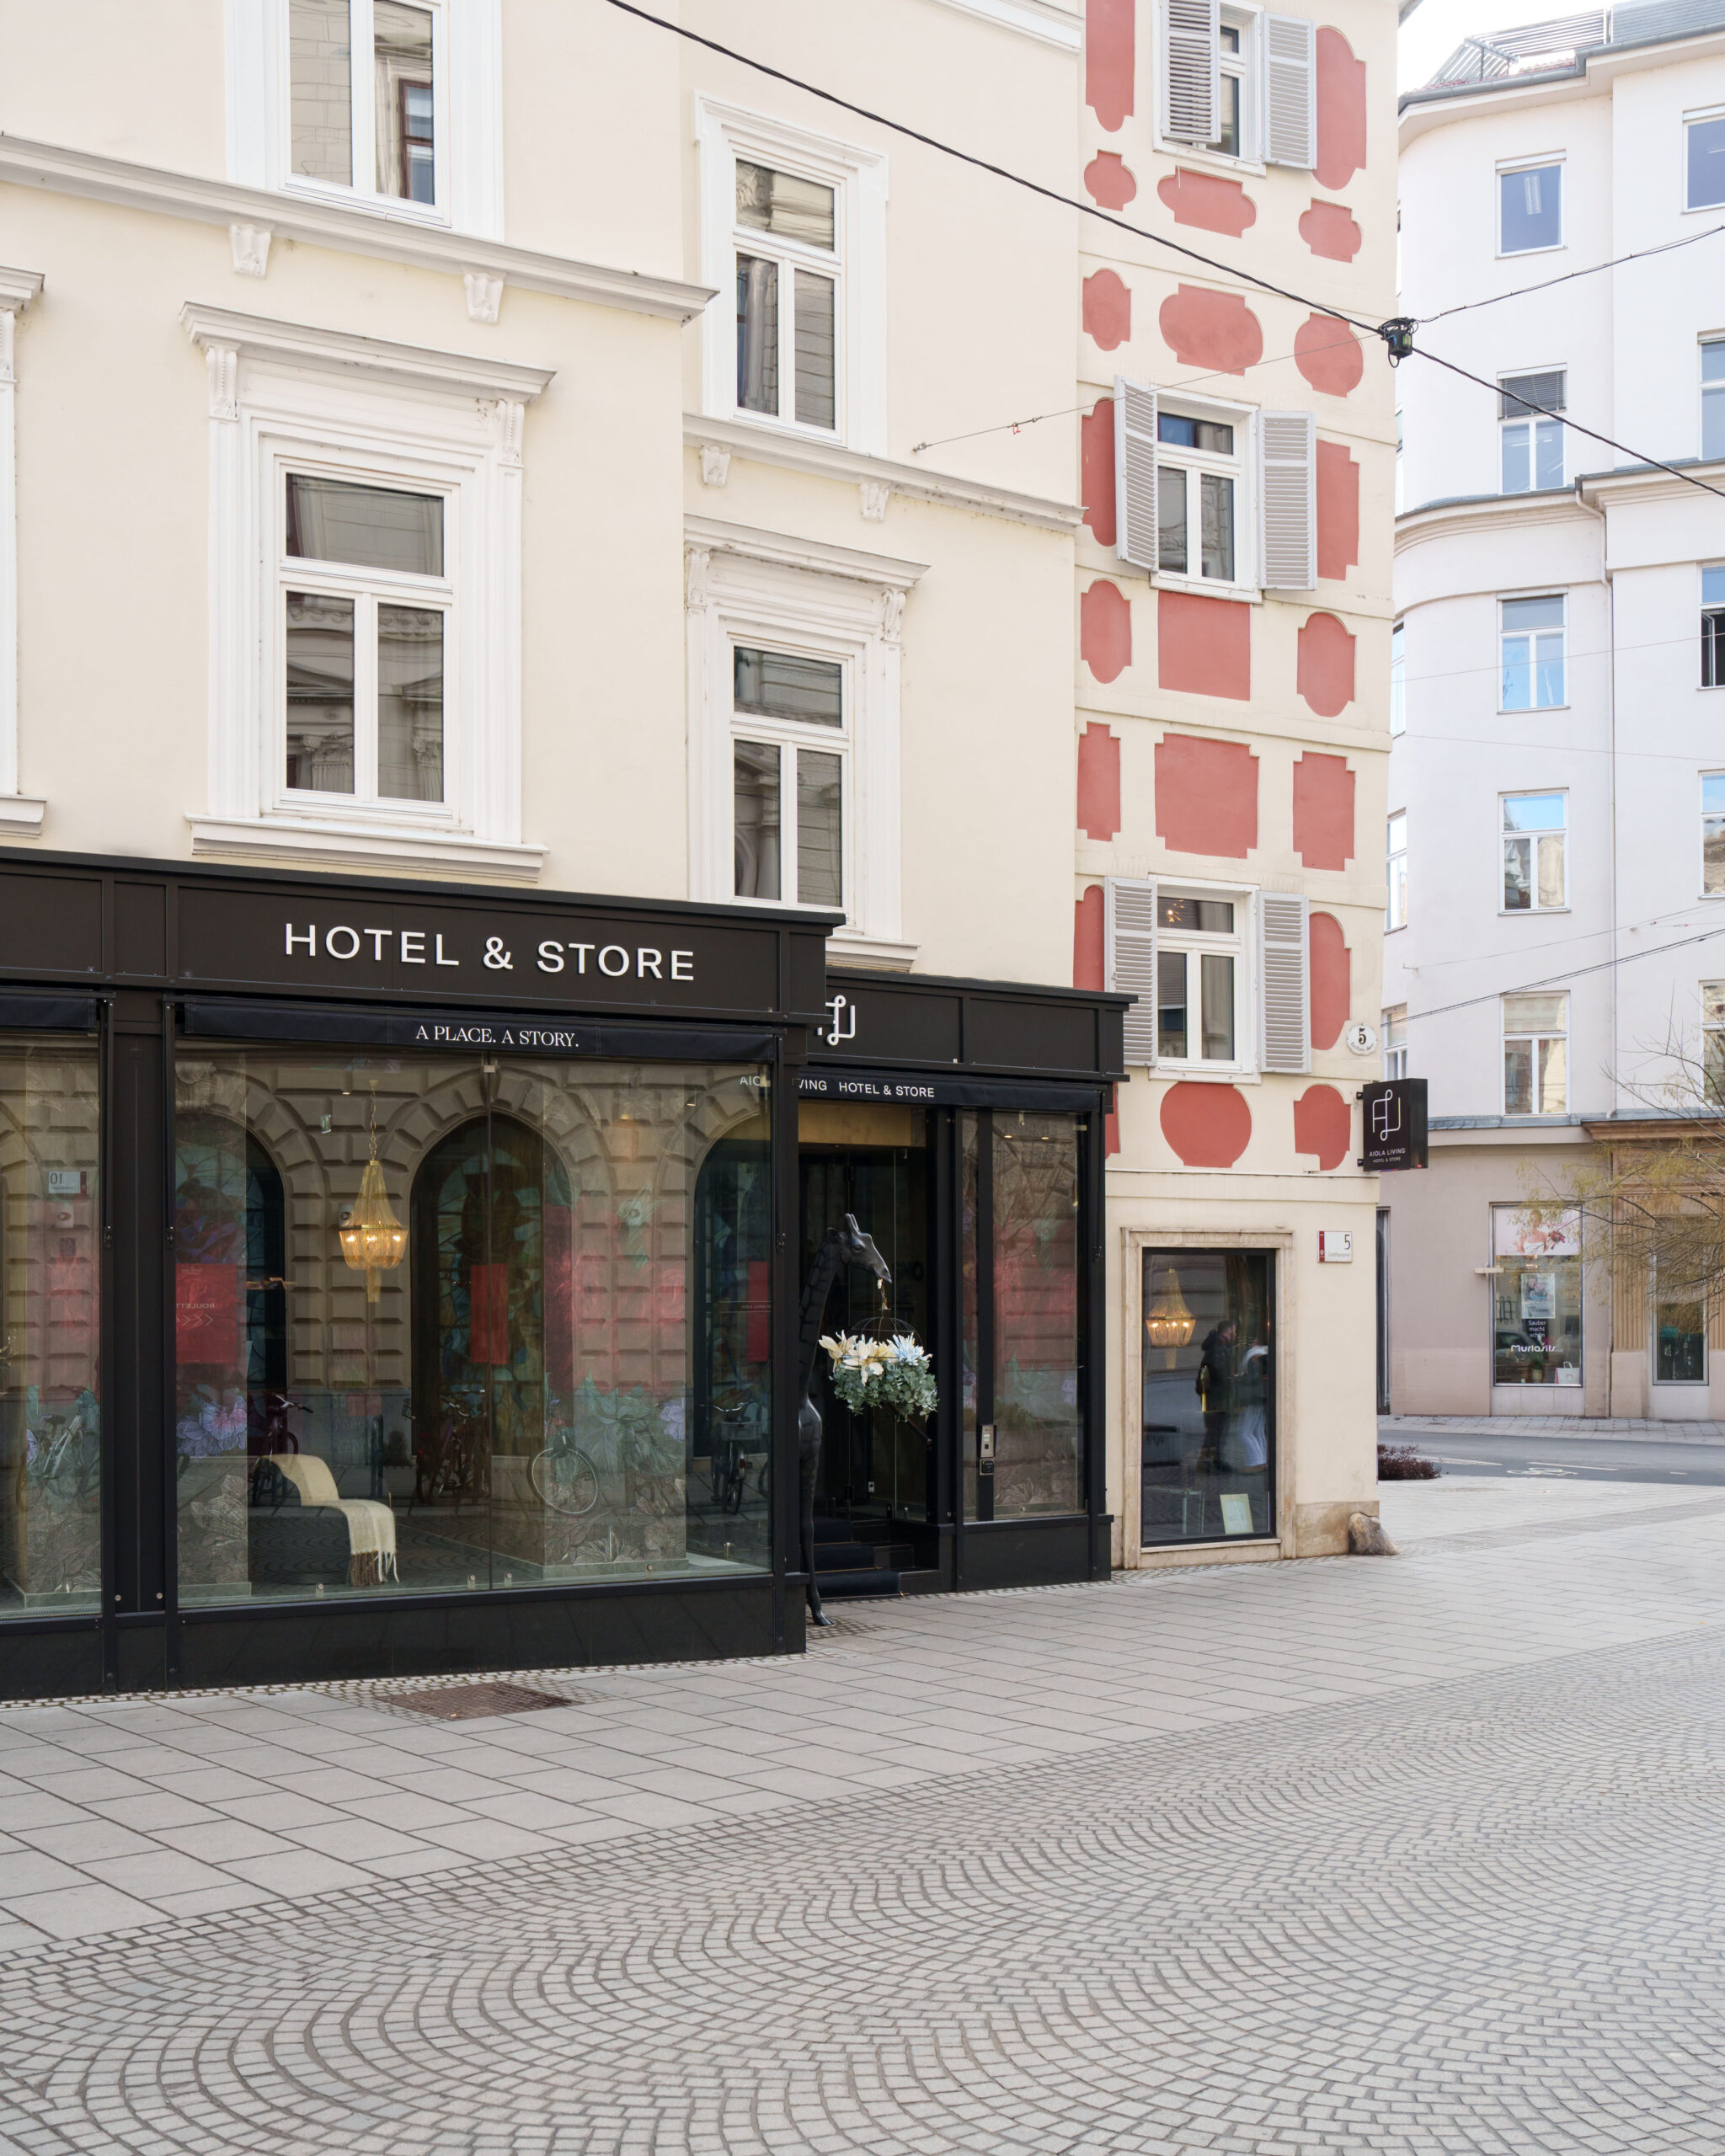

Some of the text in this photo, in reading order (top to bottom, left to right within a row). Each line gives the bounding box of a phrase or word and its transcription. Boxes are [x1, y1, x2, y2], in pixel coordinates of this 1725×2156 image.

[286, 923, 694, 981] HOTEL & STORE
[415, 1025, 579, 1048] A PLACE. A STORY.
[1359, 1027, 1367, 1044] 5
[838, 1081, 880, 1095] HOTEL
[884, 1085, 892, 1096] &
[895, 1086, 935, 1098] STORE
[1344, 1234, 1351, 1250] 5
